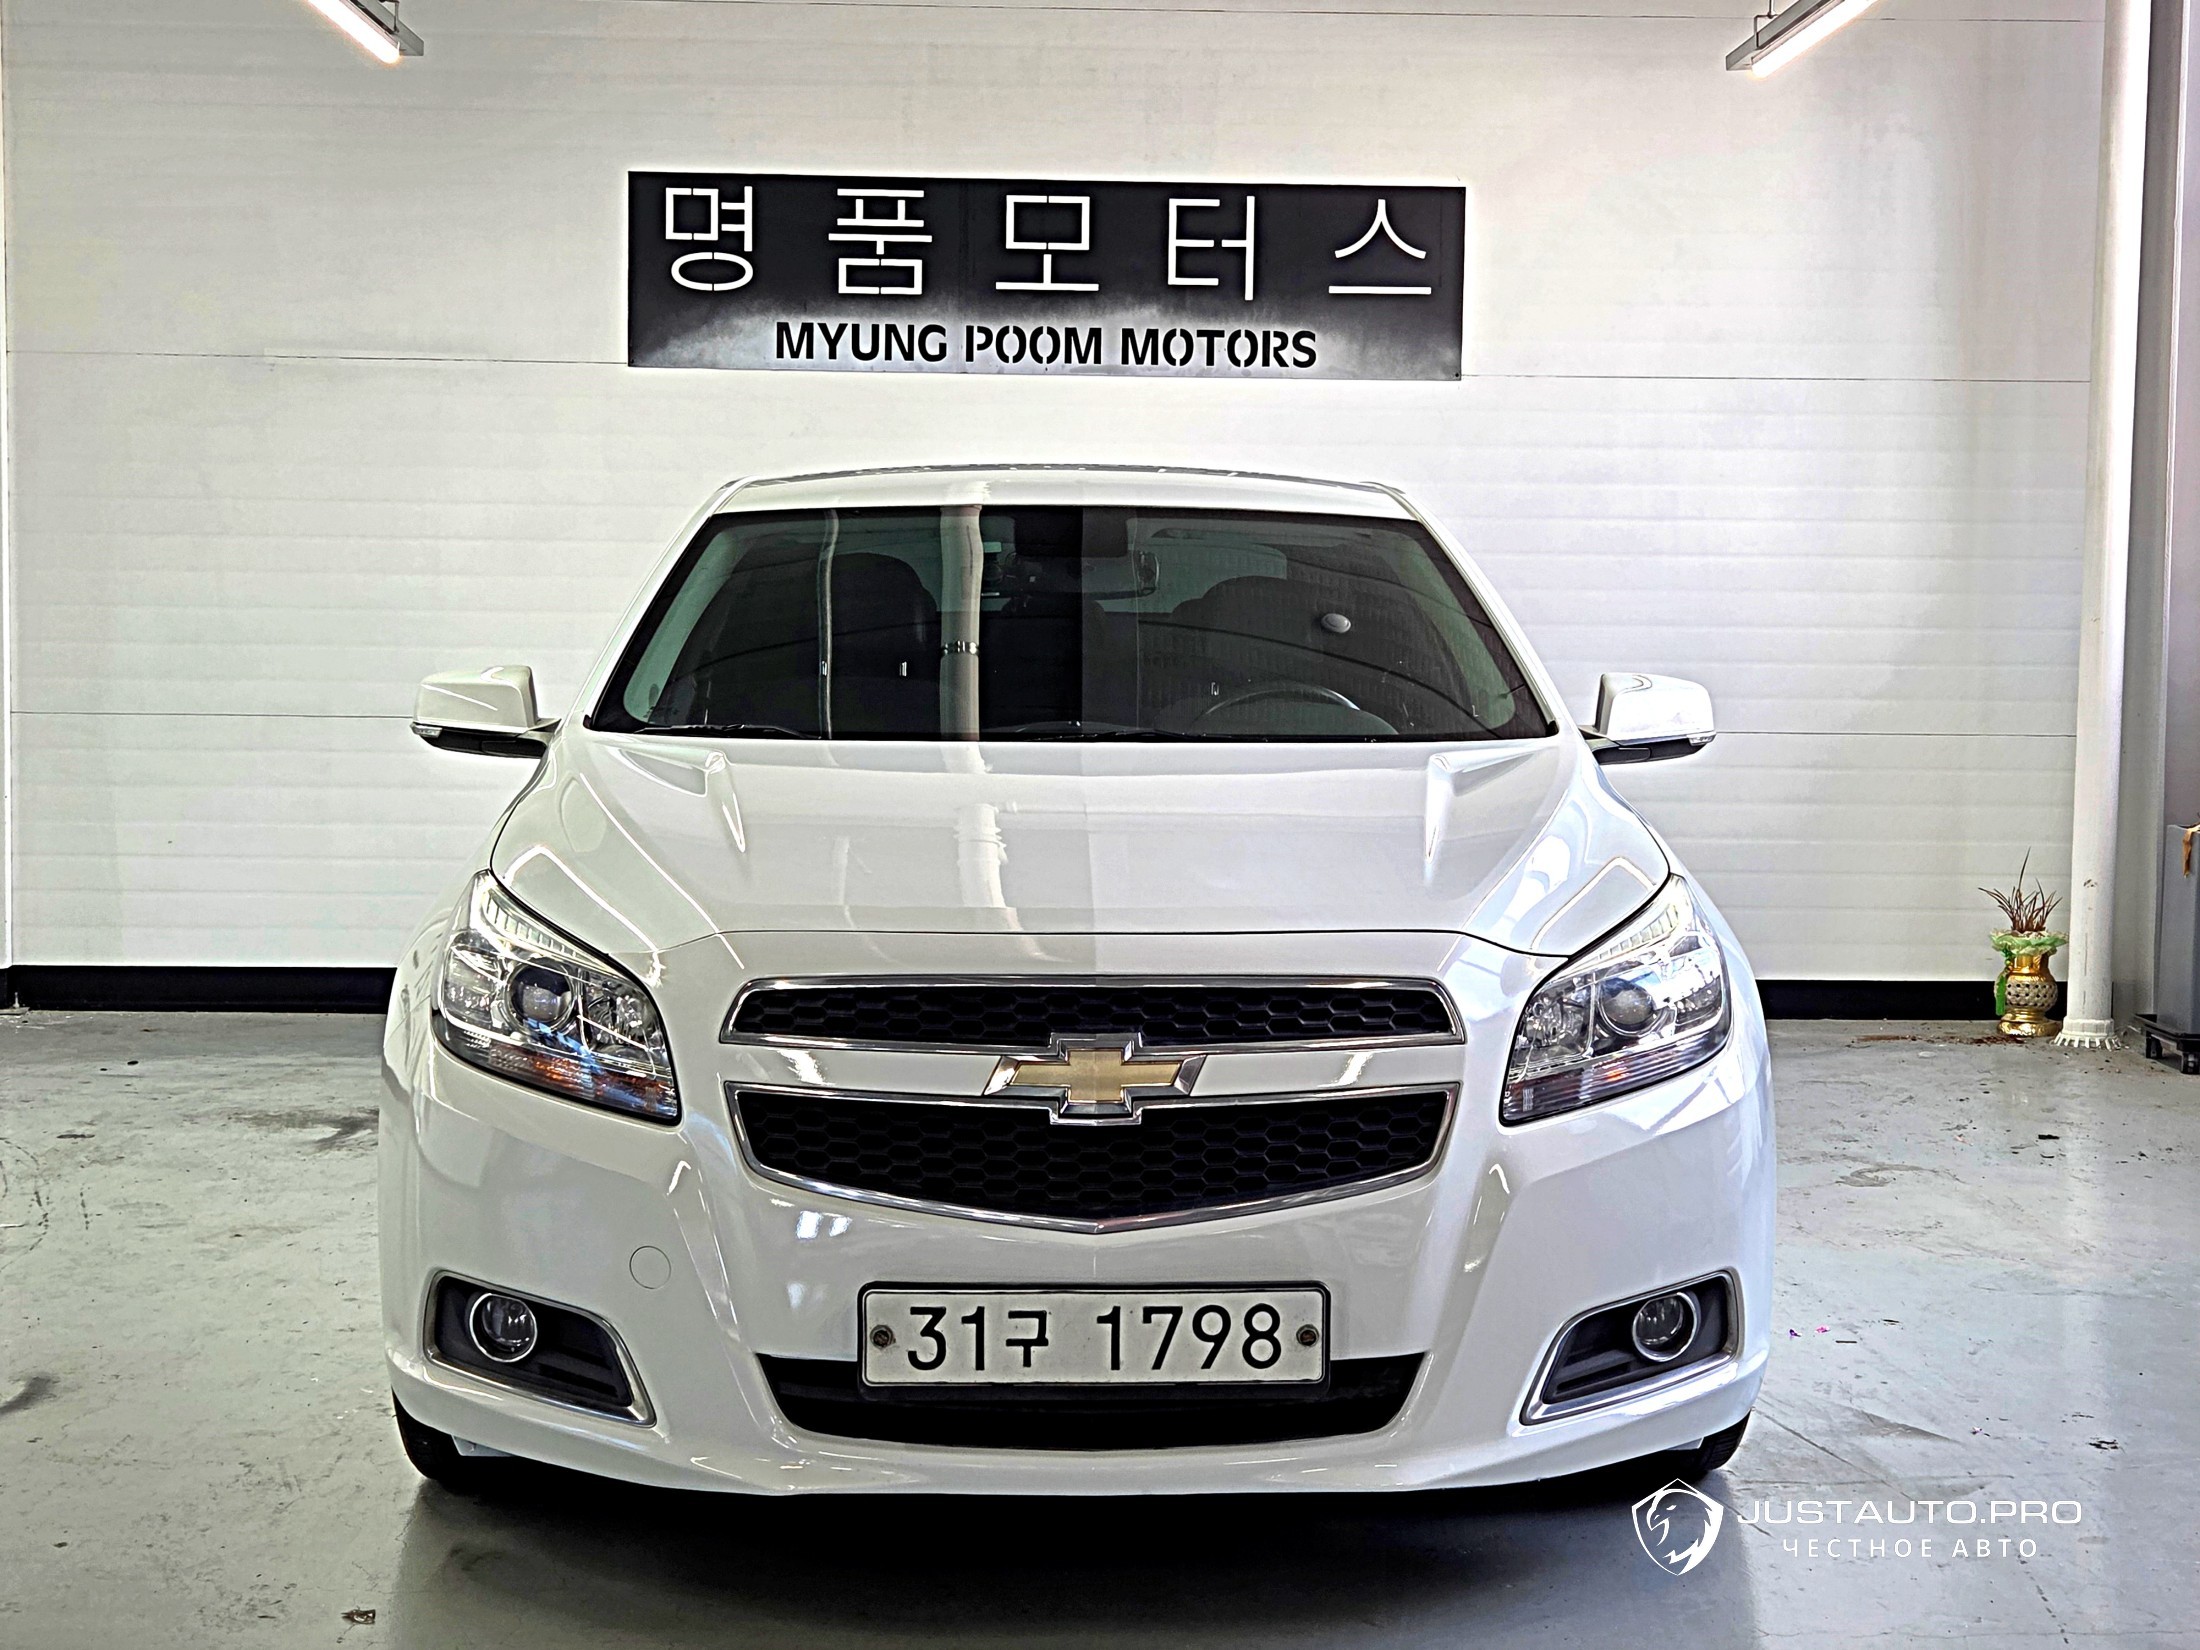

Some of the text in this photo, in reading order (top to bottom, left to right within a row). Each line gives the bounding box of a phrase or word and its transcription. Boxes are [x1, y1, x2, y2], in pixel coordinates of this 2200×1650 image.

[664, 184, 1432, 301] 명품모터스
[775, 321, 1318, 370] MYUNG POOM MOTORS
[907, 1303, 1282, 1371] 31구 1798
